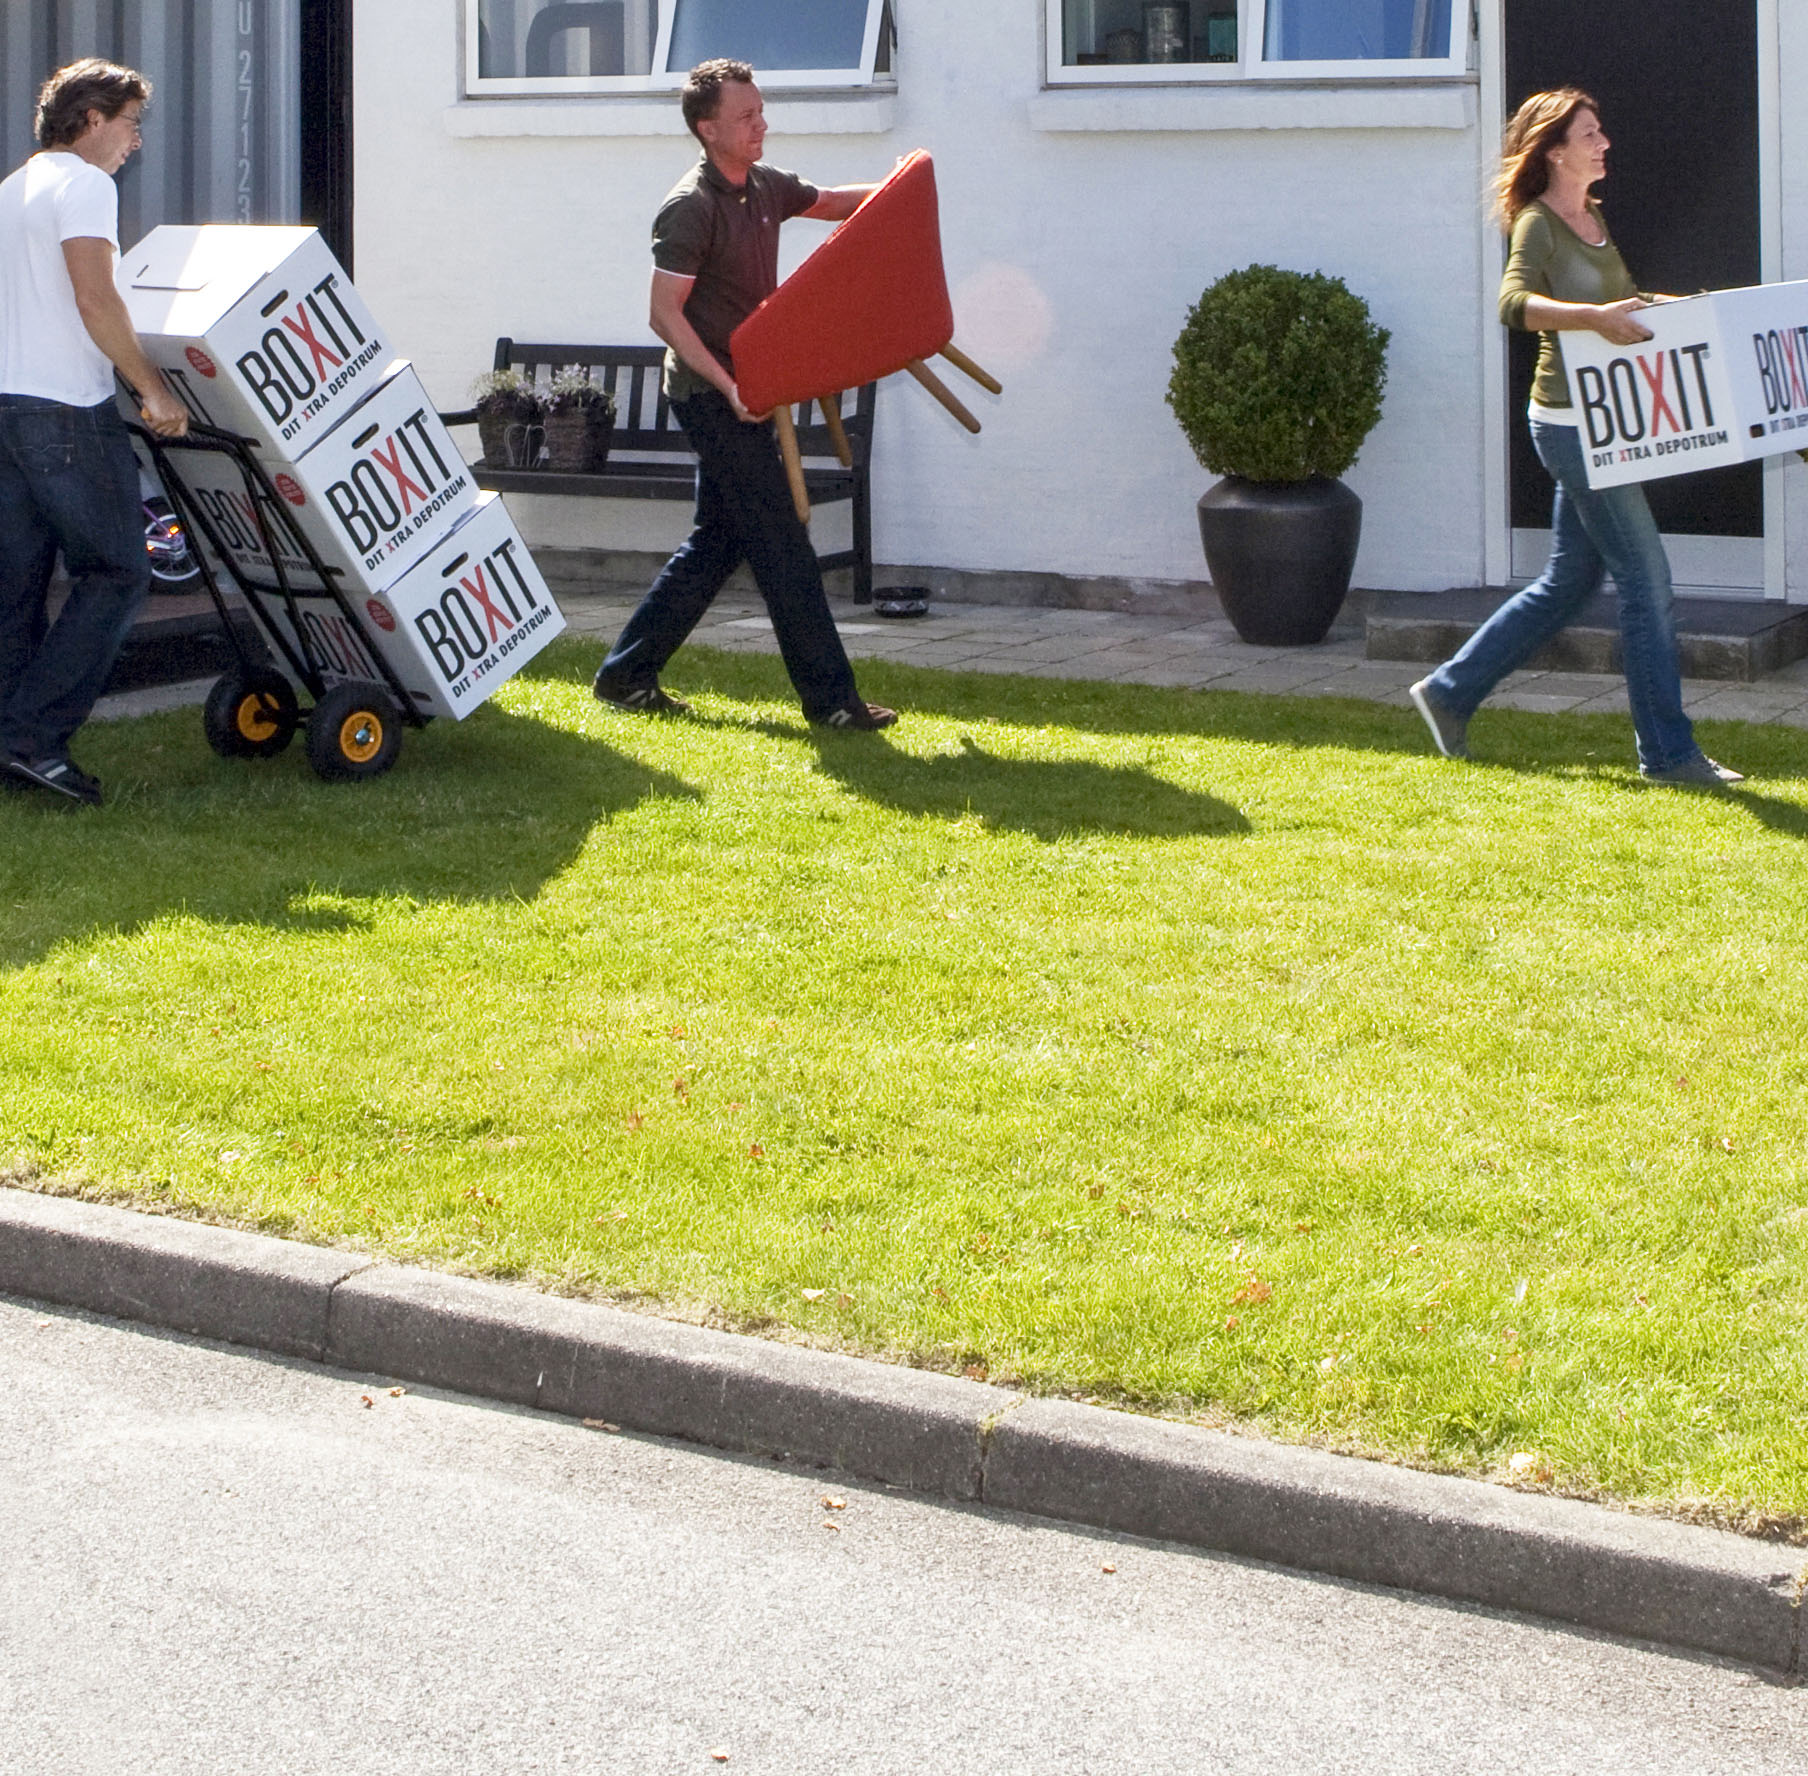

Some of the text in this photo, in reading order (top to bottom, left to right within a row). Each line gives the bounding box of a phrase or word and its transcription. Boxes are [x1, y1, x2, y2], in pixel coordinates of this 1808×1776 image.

[281, 339, 382, 441] DIT XTRA DEPOTRUM
[1592, 430, 1729, 468] DIT XTRA DEPOTRUM
[365, 475, 467, 571] DIT XTRA DEPOTRUM
[451, 604, 552, 698] DIT XTRA DEPOTRUM
